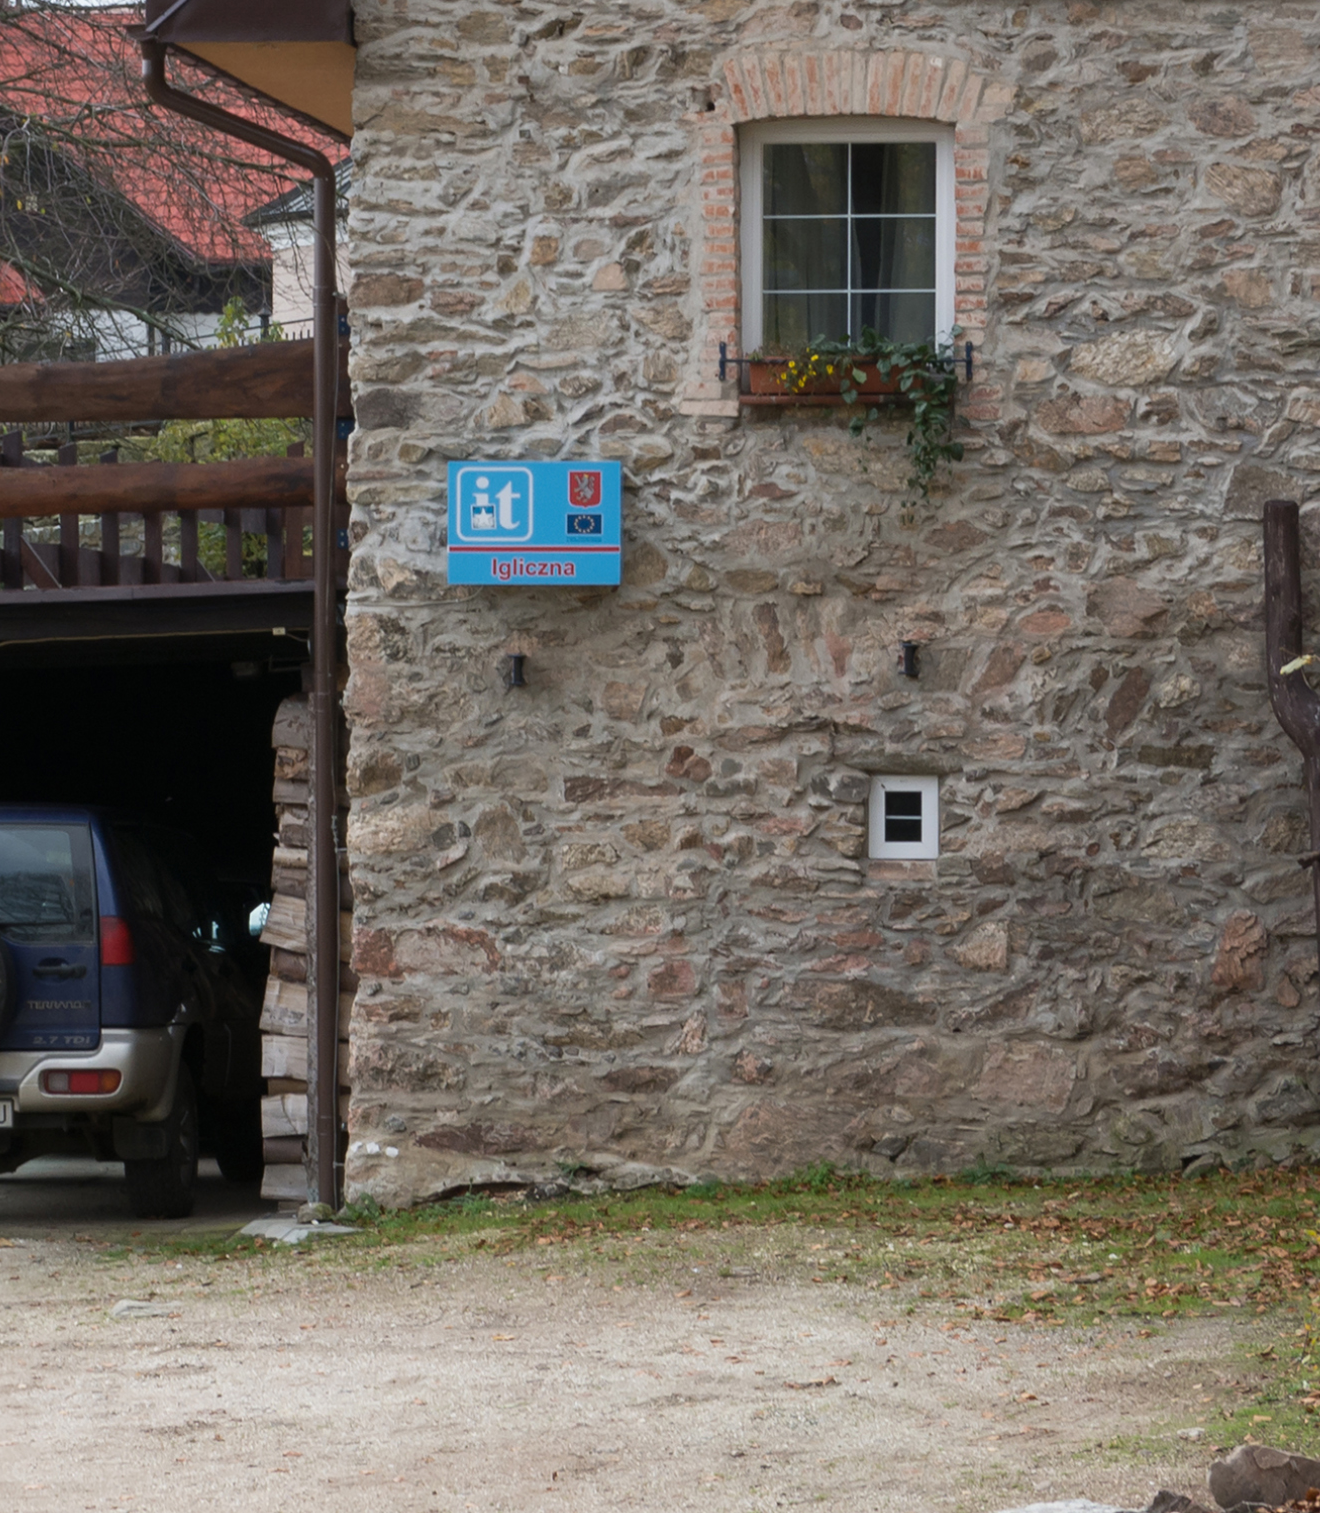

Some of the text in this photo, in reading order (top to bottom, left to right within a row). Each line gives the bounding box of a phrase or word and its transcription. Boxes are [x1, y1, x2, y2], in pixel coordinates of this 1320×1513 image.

[472, 476, 521, 530] it
[491, 557, 576, 582] Igliczna
[27, 1000, 82, 1010] TERRANO
[33, 1035, 58, 1045] 2.7
